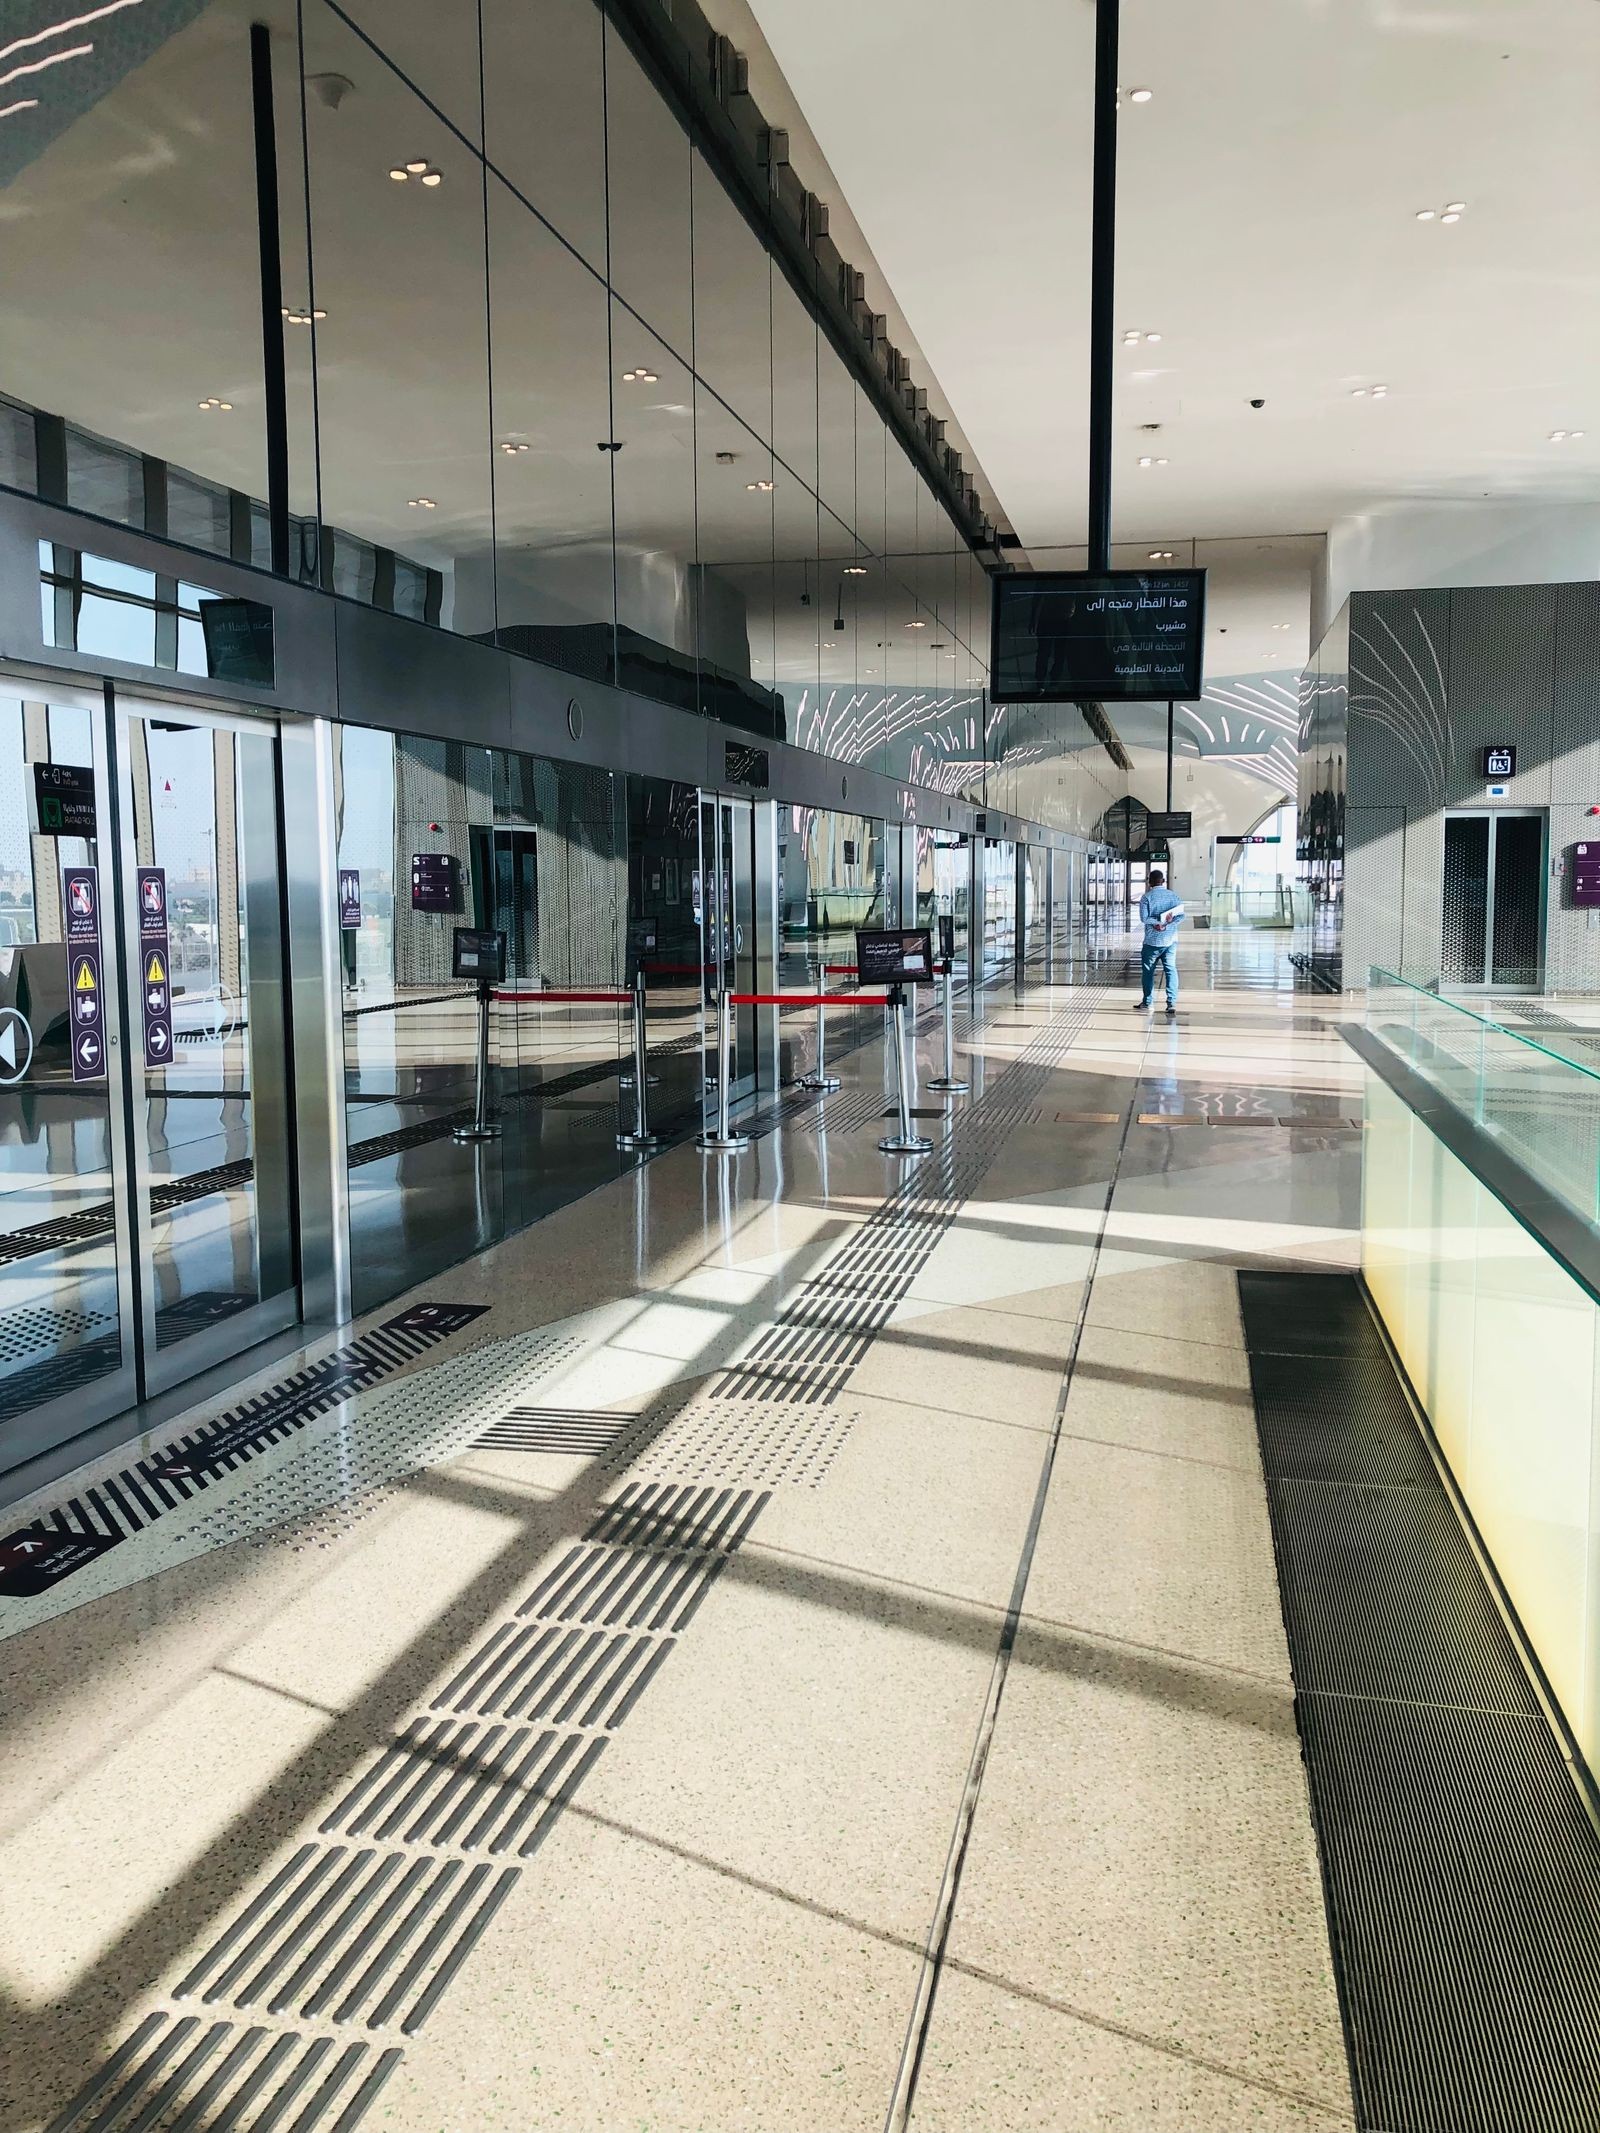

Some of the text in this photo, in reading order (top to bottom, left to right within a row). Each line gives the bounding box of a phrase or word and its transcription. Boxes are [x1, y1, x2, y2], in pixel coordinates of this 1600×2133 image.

[1086, 596, 1188, 612] هذا القطار متجه إلى
[1155, 620, 1187, 632] مشيرب
[1114, 664, 1185, 675] المدينة التعليمية
